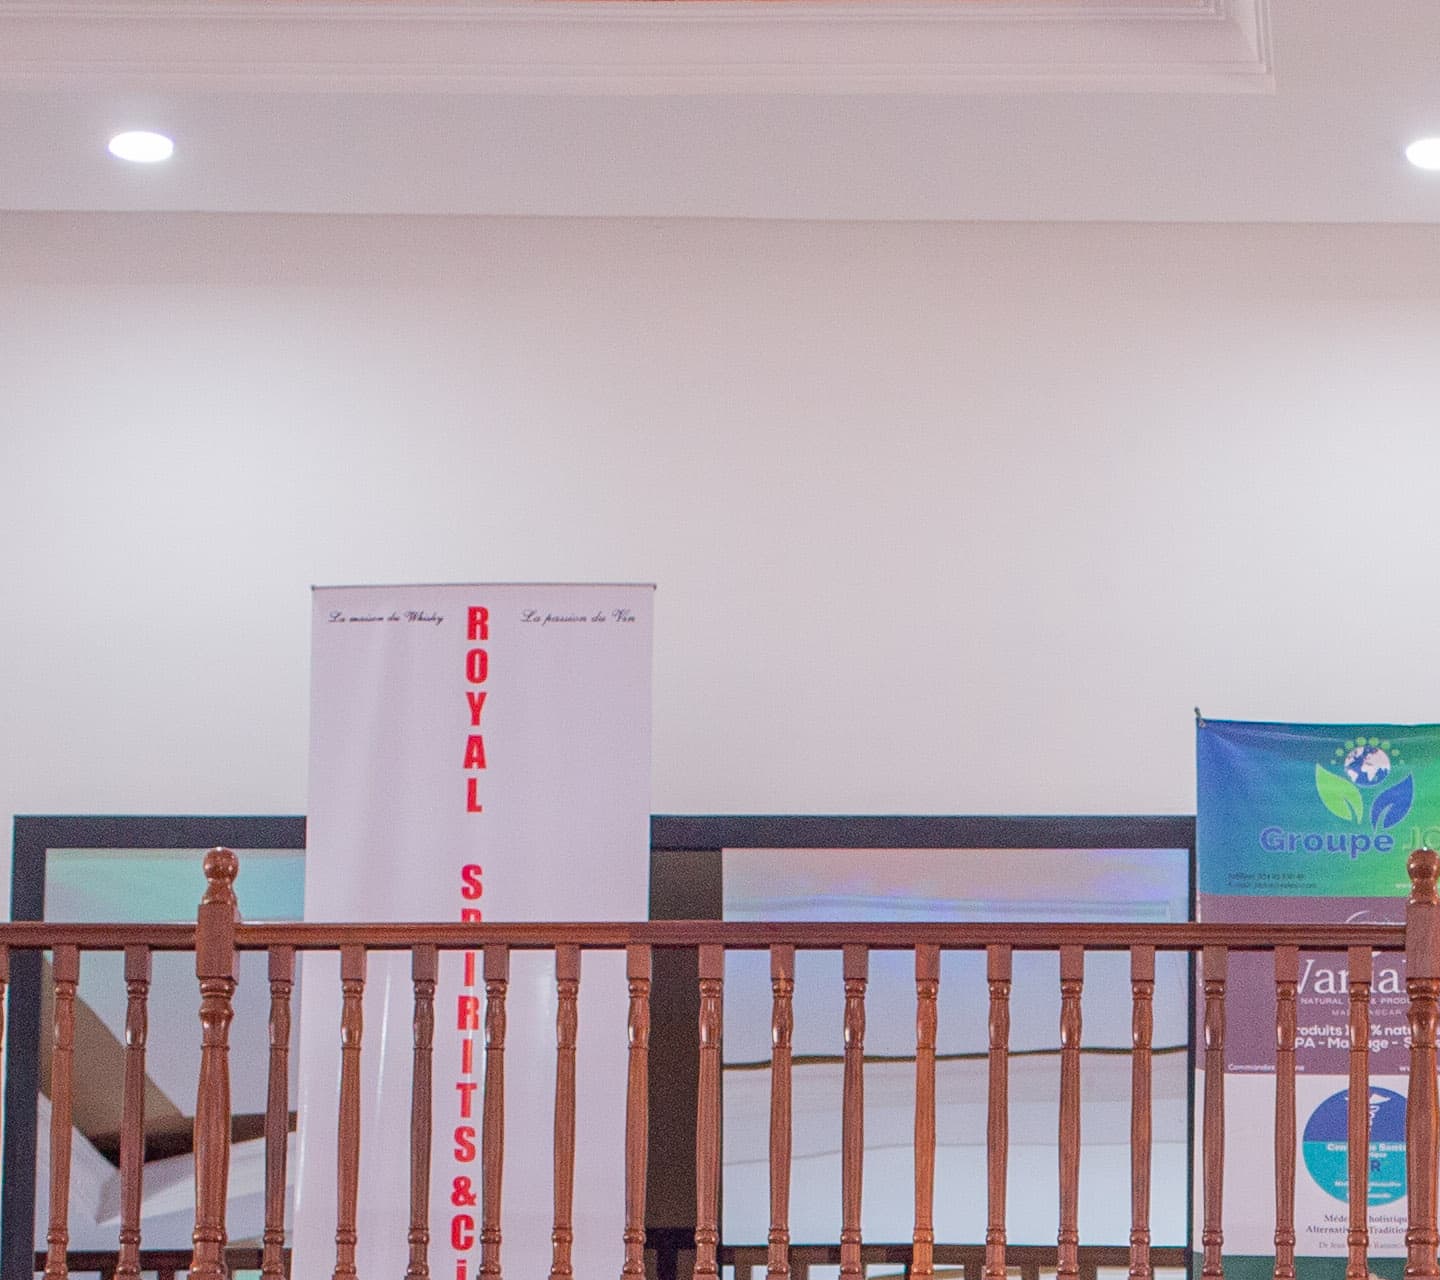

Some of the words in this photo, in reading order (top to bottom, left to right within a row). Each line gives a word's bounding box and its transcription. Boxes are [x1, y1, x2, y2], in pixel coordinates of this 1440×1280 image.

[405, 610, 444, 625] Whisky
[520, 608, 541, 623] La
[542, 611, 588, 626] passion
[590, 610, 607, 623] du
[611, 608, 636, 623] Vin
[463, 606, 489, 813] ROYAL
[1259, 826, 1394, 860] Groupe
